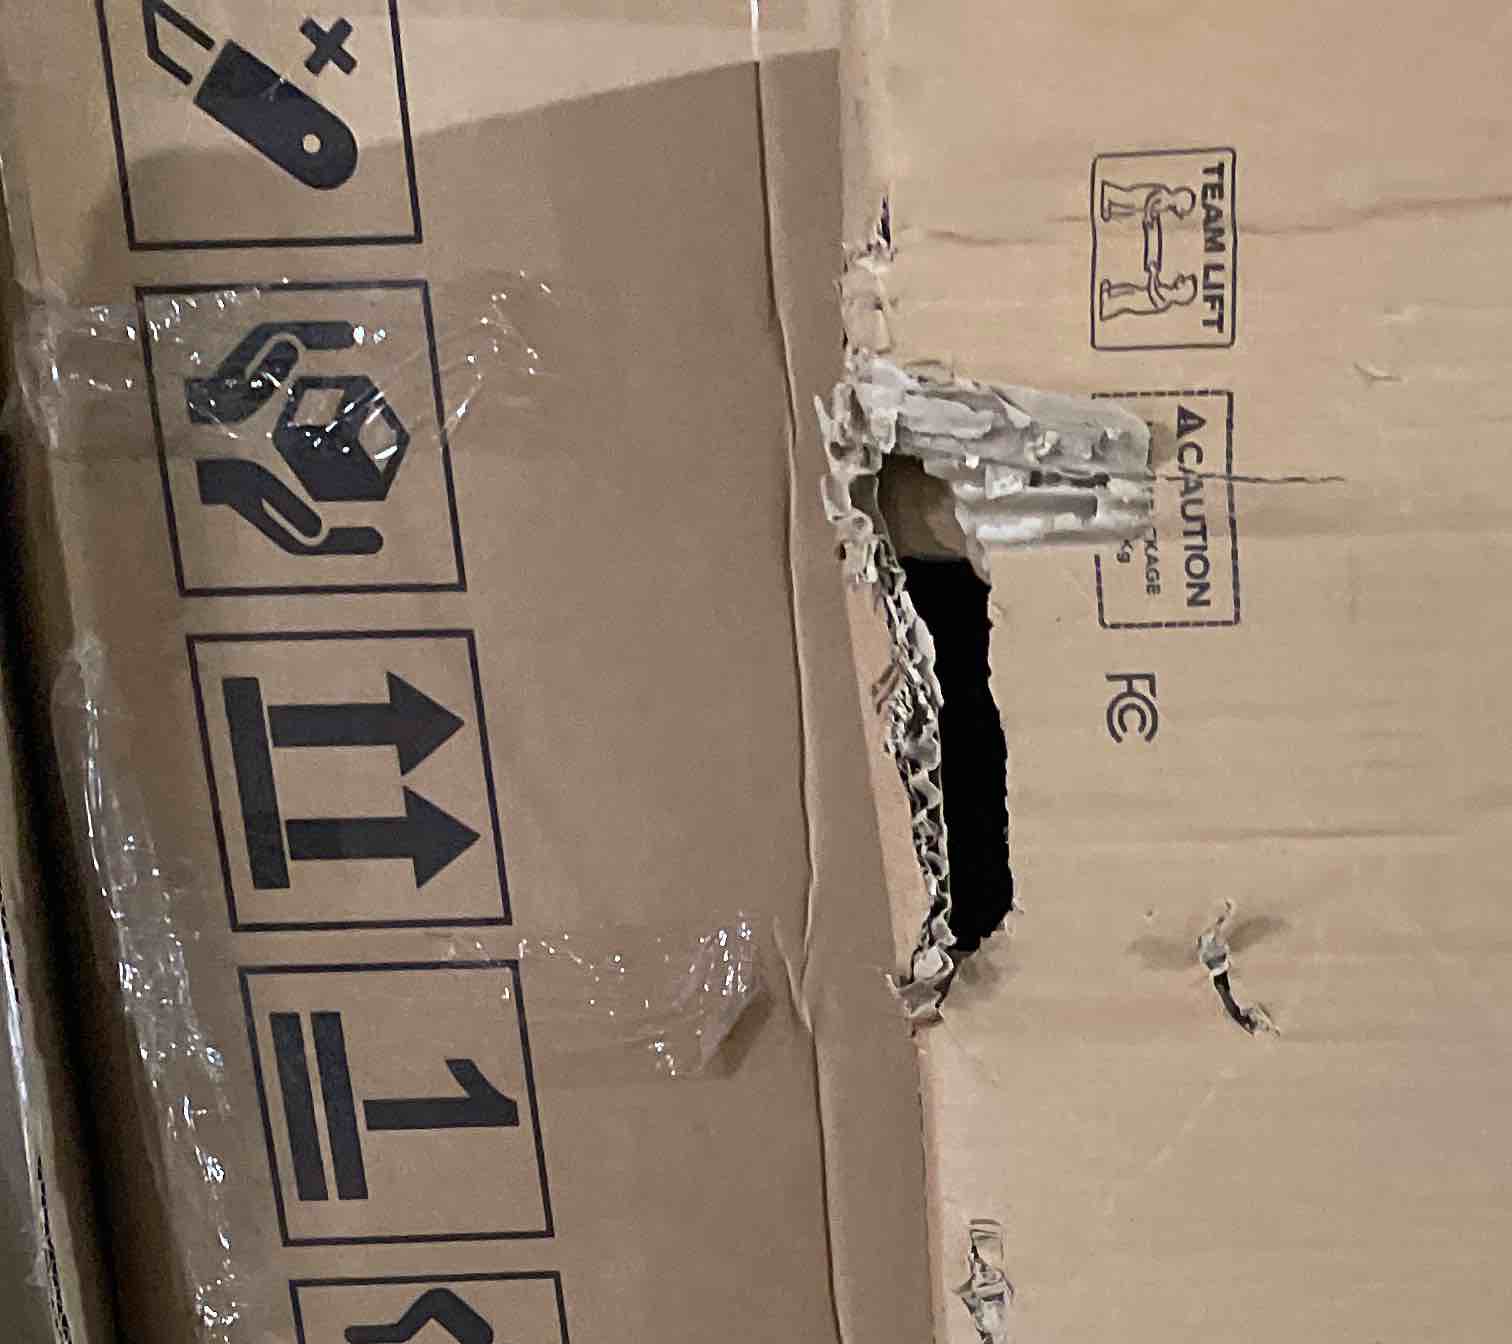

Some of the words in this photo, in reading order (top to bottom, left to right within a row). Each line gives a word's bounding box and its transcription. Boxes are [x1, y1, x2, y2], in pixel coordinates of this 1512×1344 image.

[1201, 161, 1223, 253] TEAM
[1201, 263, 1223, 334] LIFT
[1177, 440, 1210, 608] CAUTION
